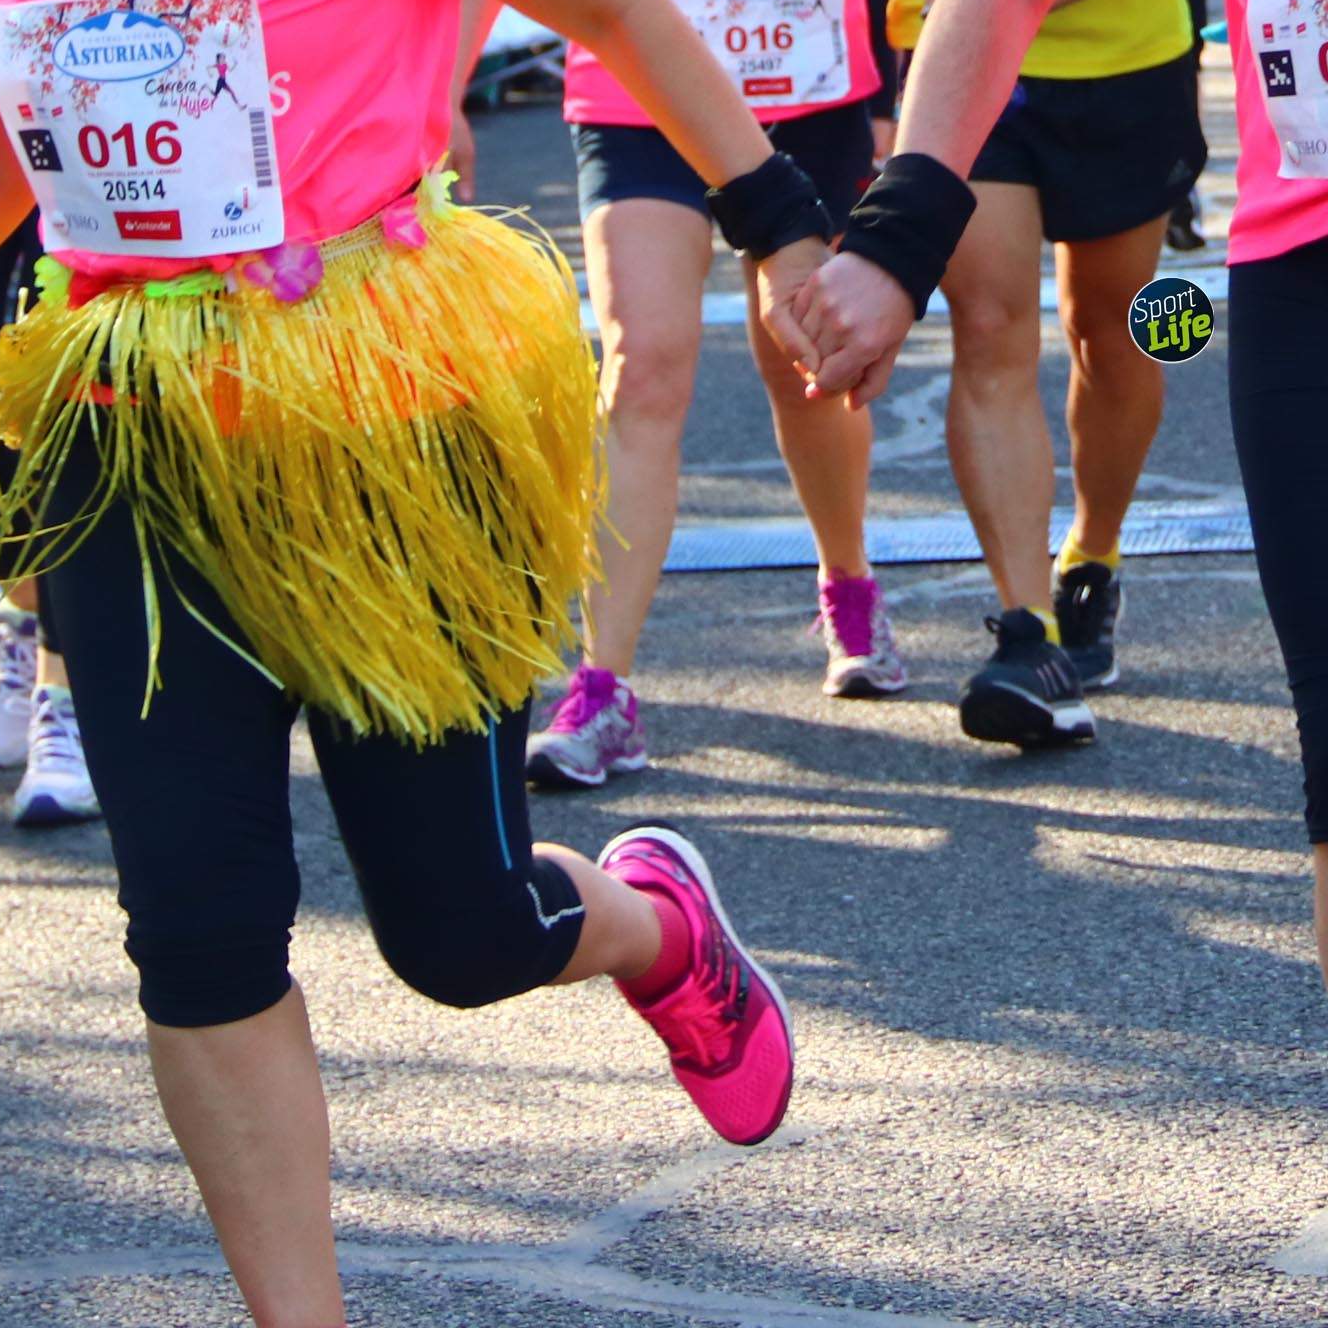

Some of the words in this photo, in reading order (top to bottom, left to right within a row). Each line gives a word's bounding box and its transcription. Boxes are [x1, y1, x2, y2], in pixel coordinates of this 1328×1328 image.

[724, 22, 795, 54] 016
[62, 40, 176, 68] ASTURIANA
[144, 78, 197, 96] Carrera
[77, 120, 183, 170] 016
[103, 178, 167, 201] 20514
[210, 223, 261, 240] ZURICH
